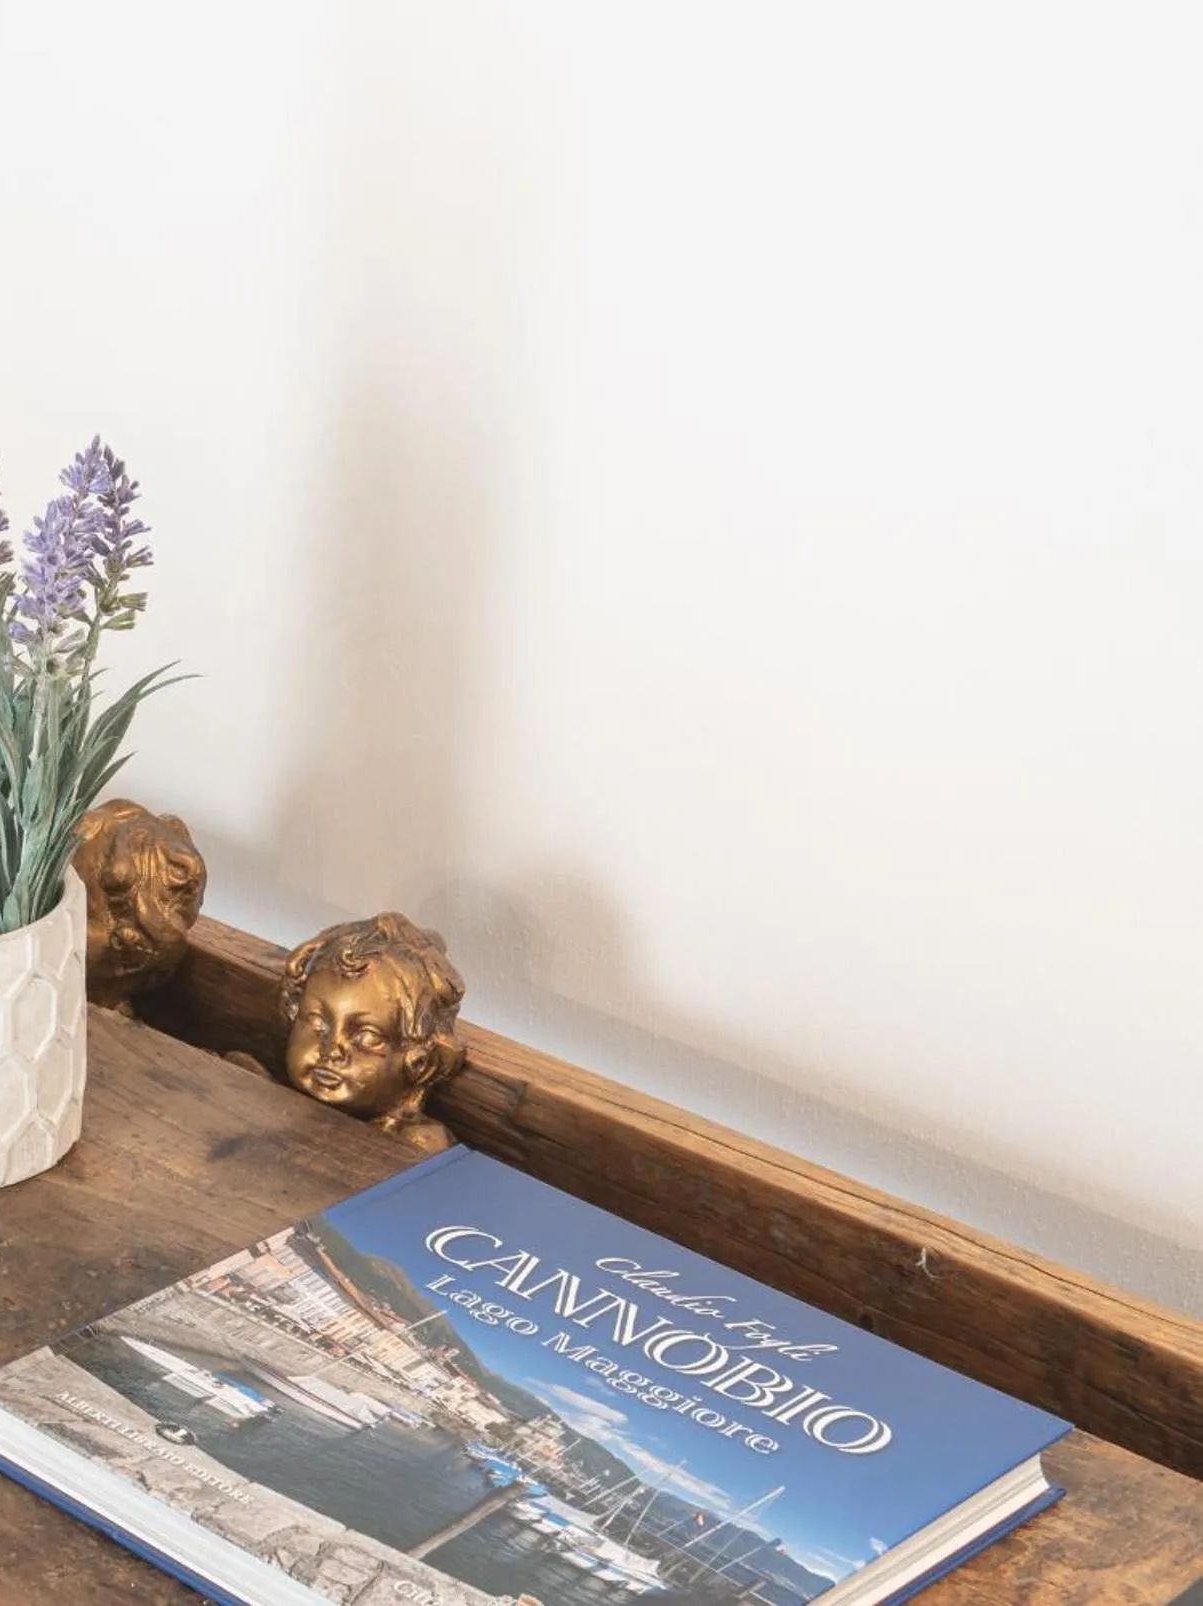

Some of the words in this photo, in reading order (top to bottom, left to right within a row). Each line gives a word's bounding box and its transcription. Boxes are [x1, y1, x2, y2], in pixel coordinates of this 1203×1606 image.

[425, 1225, 893, 1455] CANNOBIO
[425, 1273, 538, 1337] Lago
[541, 1331, 781, 1455] Maggiore
[595, 1257, 735, 1319] Claudio
[701, 1316, 838, 1363] Fogli
